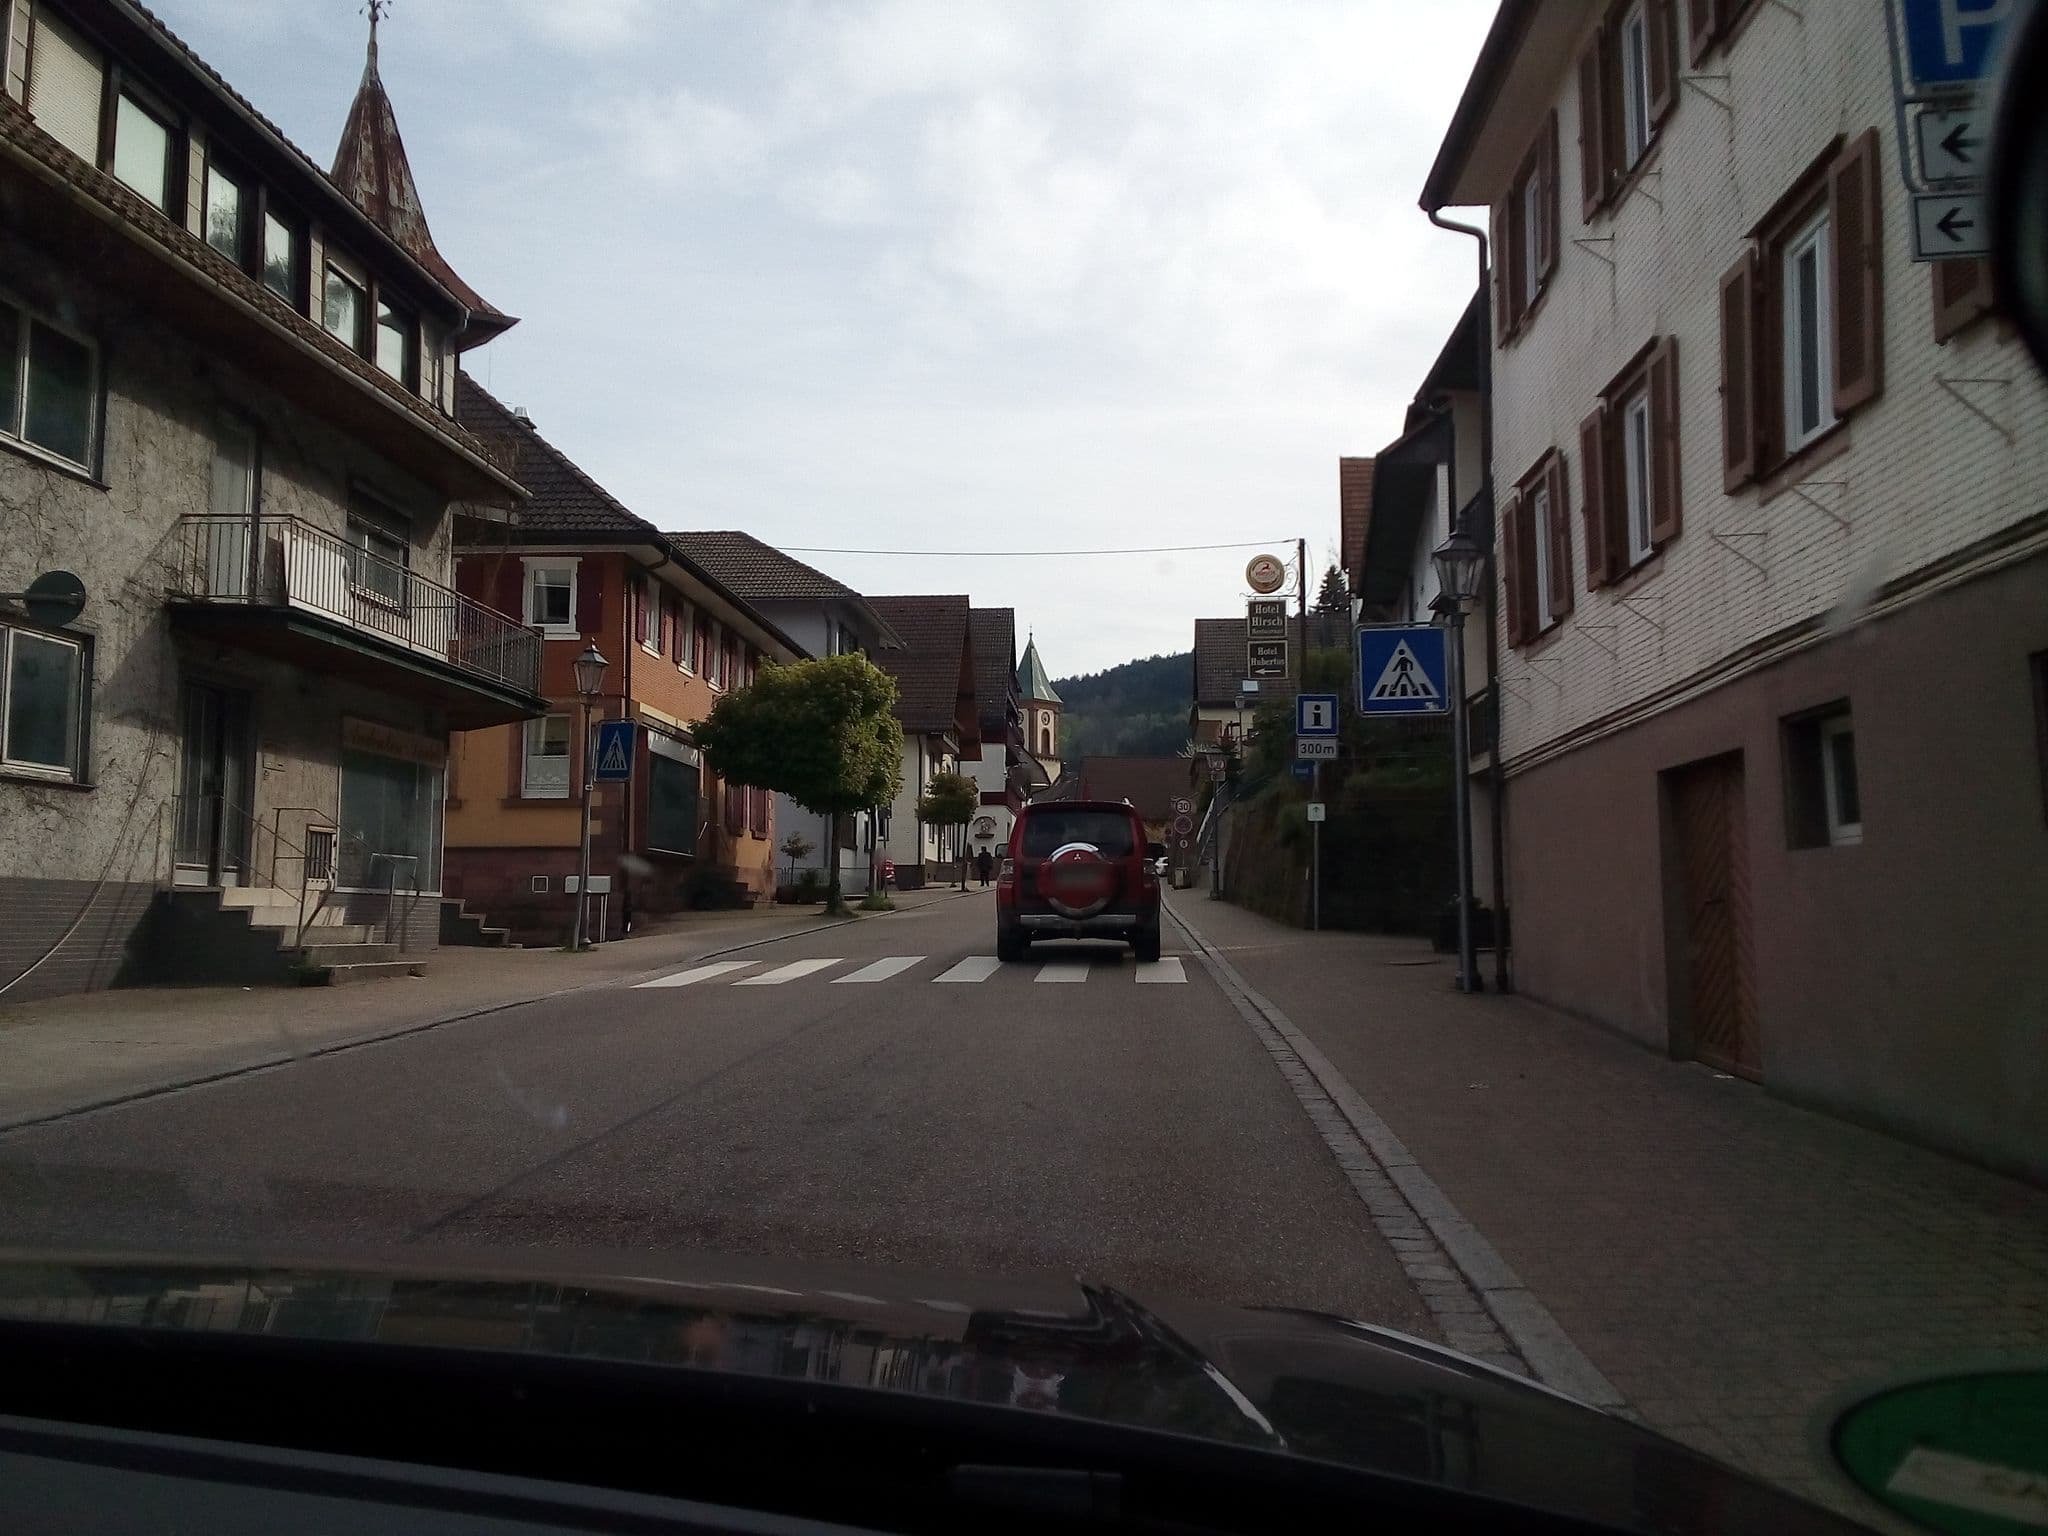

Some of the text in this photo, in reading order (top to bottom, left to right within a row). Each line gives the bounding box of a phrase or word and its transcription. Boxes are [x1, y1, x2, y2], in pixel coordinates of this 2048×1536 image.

[1940, 0, 2013, 64] P
[1255, 604, 1280, 614] Hotel
[1251, 616, 1283, 627] Hirsch
[1257, 647, 1278, 656] Hotel
[1250, 657, 1286, 666] Hubertus
[1178, 802, 1189, 811] 30
